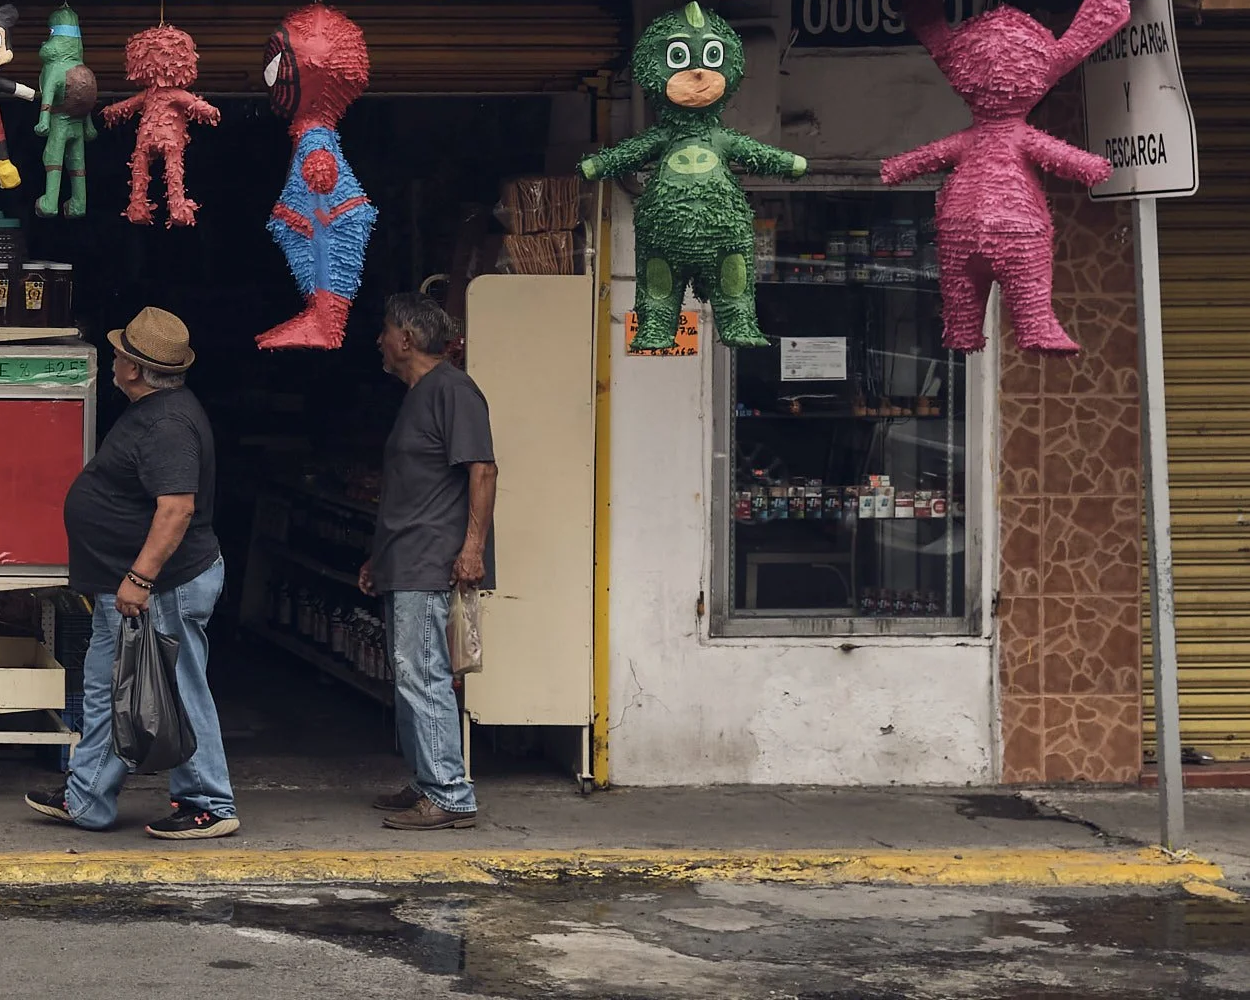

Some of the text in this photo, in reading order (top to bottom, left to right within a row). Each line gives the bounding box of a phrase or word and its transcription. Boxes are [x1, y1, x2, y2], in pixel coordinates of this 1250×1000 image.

[1130, 21, 1170, 57] CARGA
[1123, 81, 1131, 113] Y
[1105, 133, 1168, 169] DESCARGA
